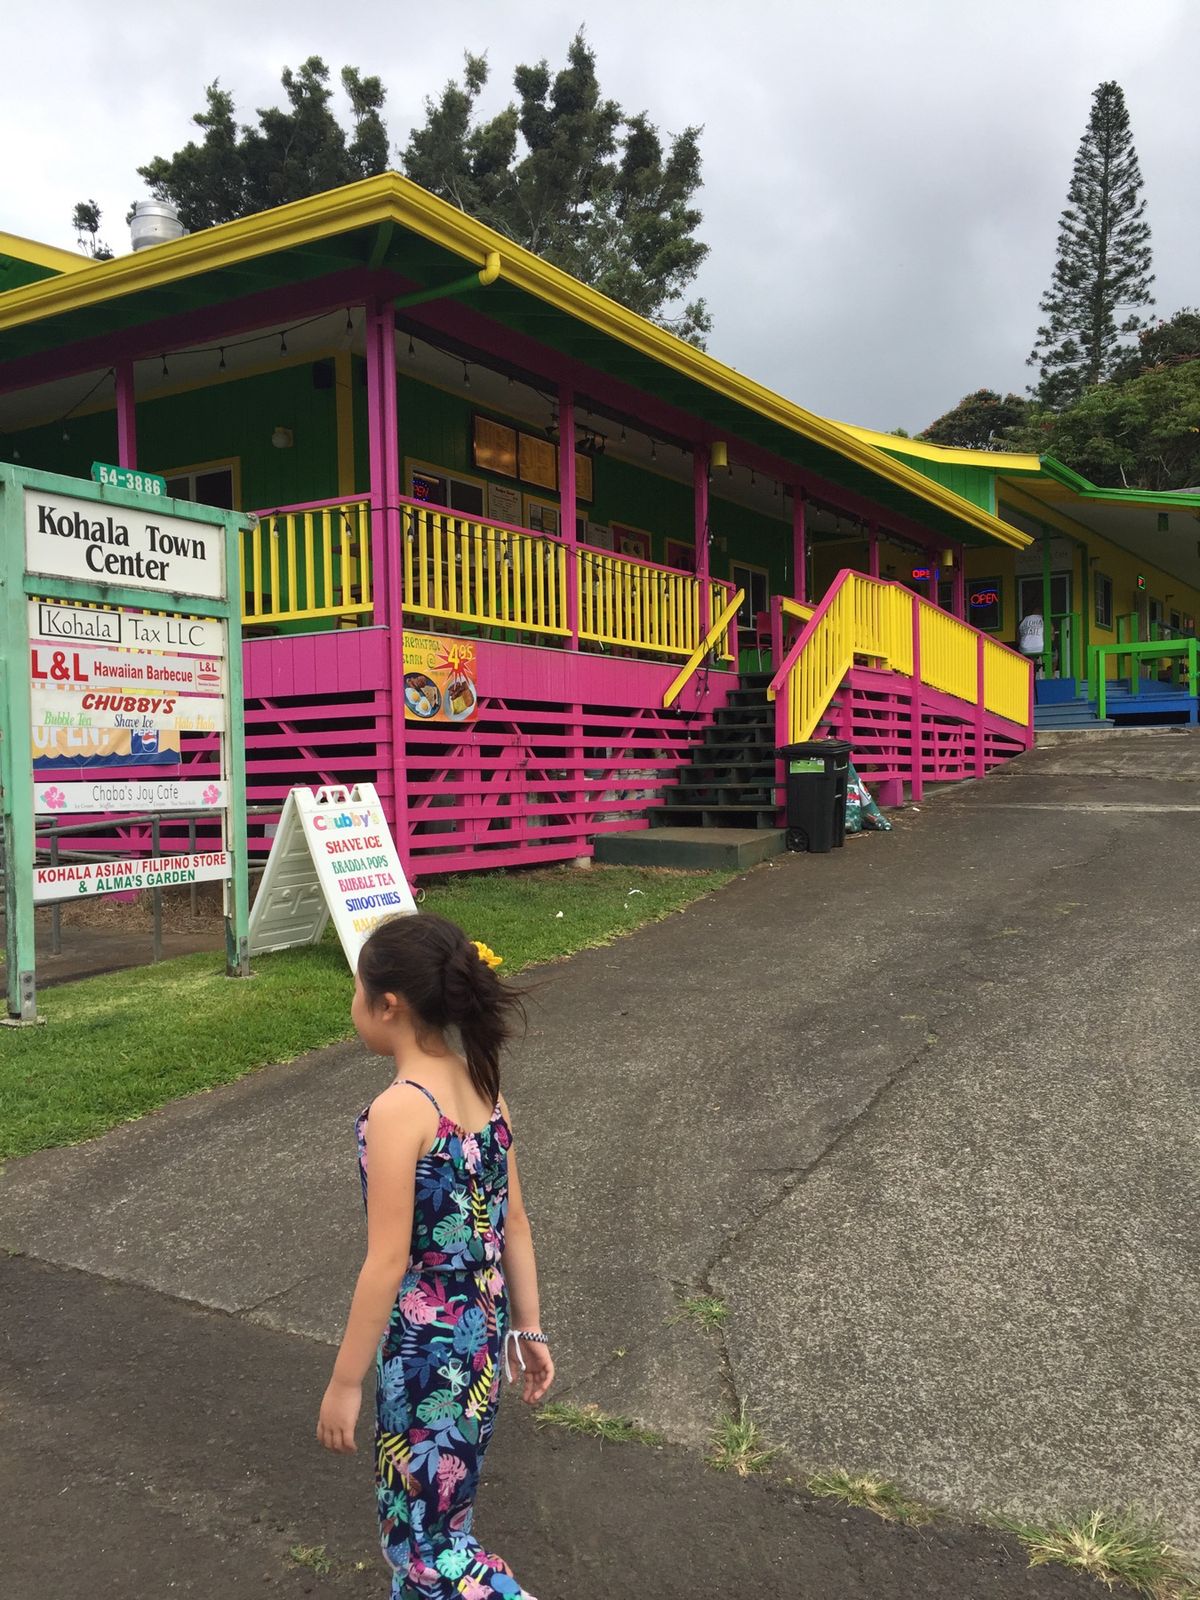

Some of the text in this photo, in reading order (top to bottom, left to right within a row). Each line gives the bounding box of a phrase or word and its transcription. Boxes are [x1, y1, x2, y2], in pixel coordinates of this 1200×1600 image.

[99, 466, 161, 496] 54-3886
[37, 504, 207, 561] Kohala Town
[85, 544, 170, 581] Center
[970, 592, 999, 606] OPEN
[46, 609, 206, 648] Kohala Tax LLC
[31, 649, 90, 683] L&L
[93, 661, 144, 680] Hawaiian
[146, 664, 193, 683] Barbecue
[199, 661, 217, 673] L&L
[81, 693, 176, 715] CHUBBY'S
[43, 710, 92, 727] Bubble Tea
[114, 713, 154, 728] Shave Ice
[92, 784, 133, 802] Chaba's
[136, 785, 154, 804] Joy
[313, 810, 380, 831] Chubby's
[325, 836, 382, 855] SHAVE ICE
[37, 866, 92, 884] KOHALA
[95, 861, 133, 878] ASIAN
[142, 856, 191, 874] FILIPINO
[193, 852, 227, 867] STORE
[331, 855, 389, 875] BRADDA POPS
[78, 868, 196, 893] & ALMA'S GARDEN
[338, 873, 396, 893] BUBBLE TEA
[345, 891, 401, 912] SMOOTHIES
